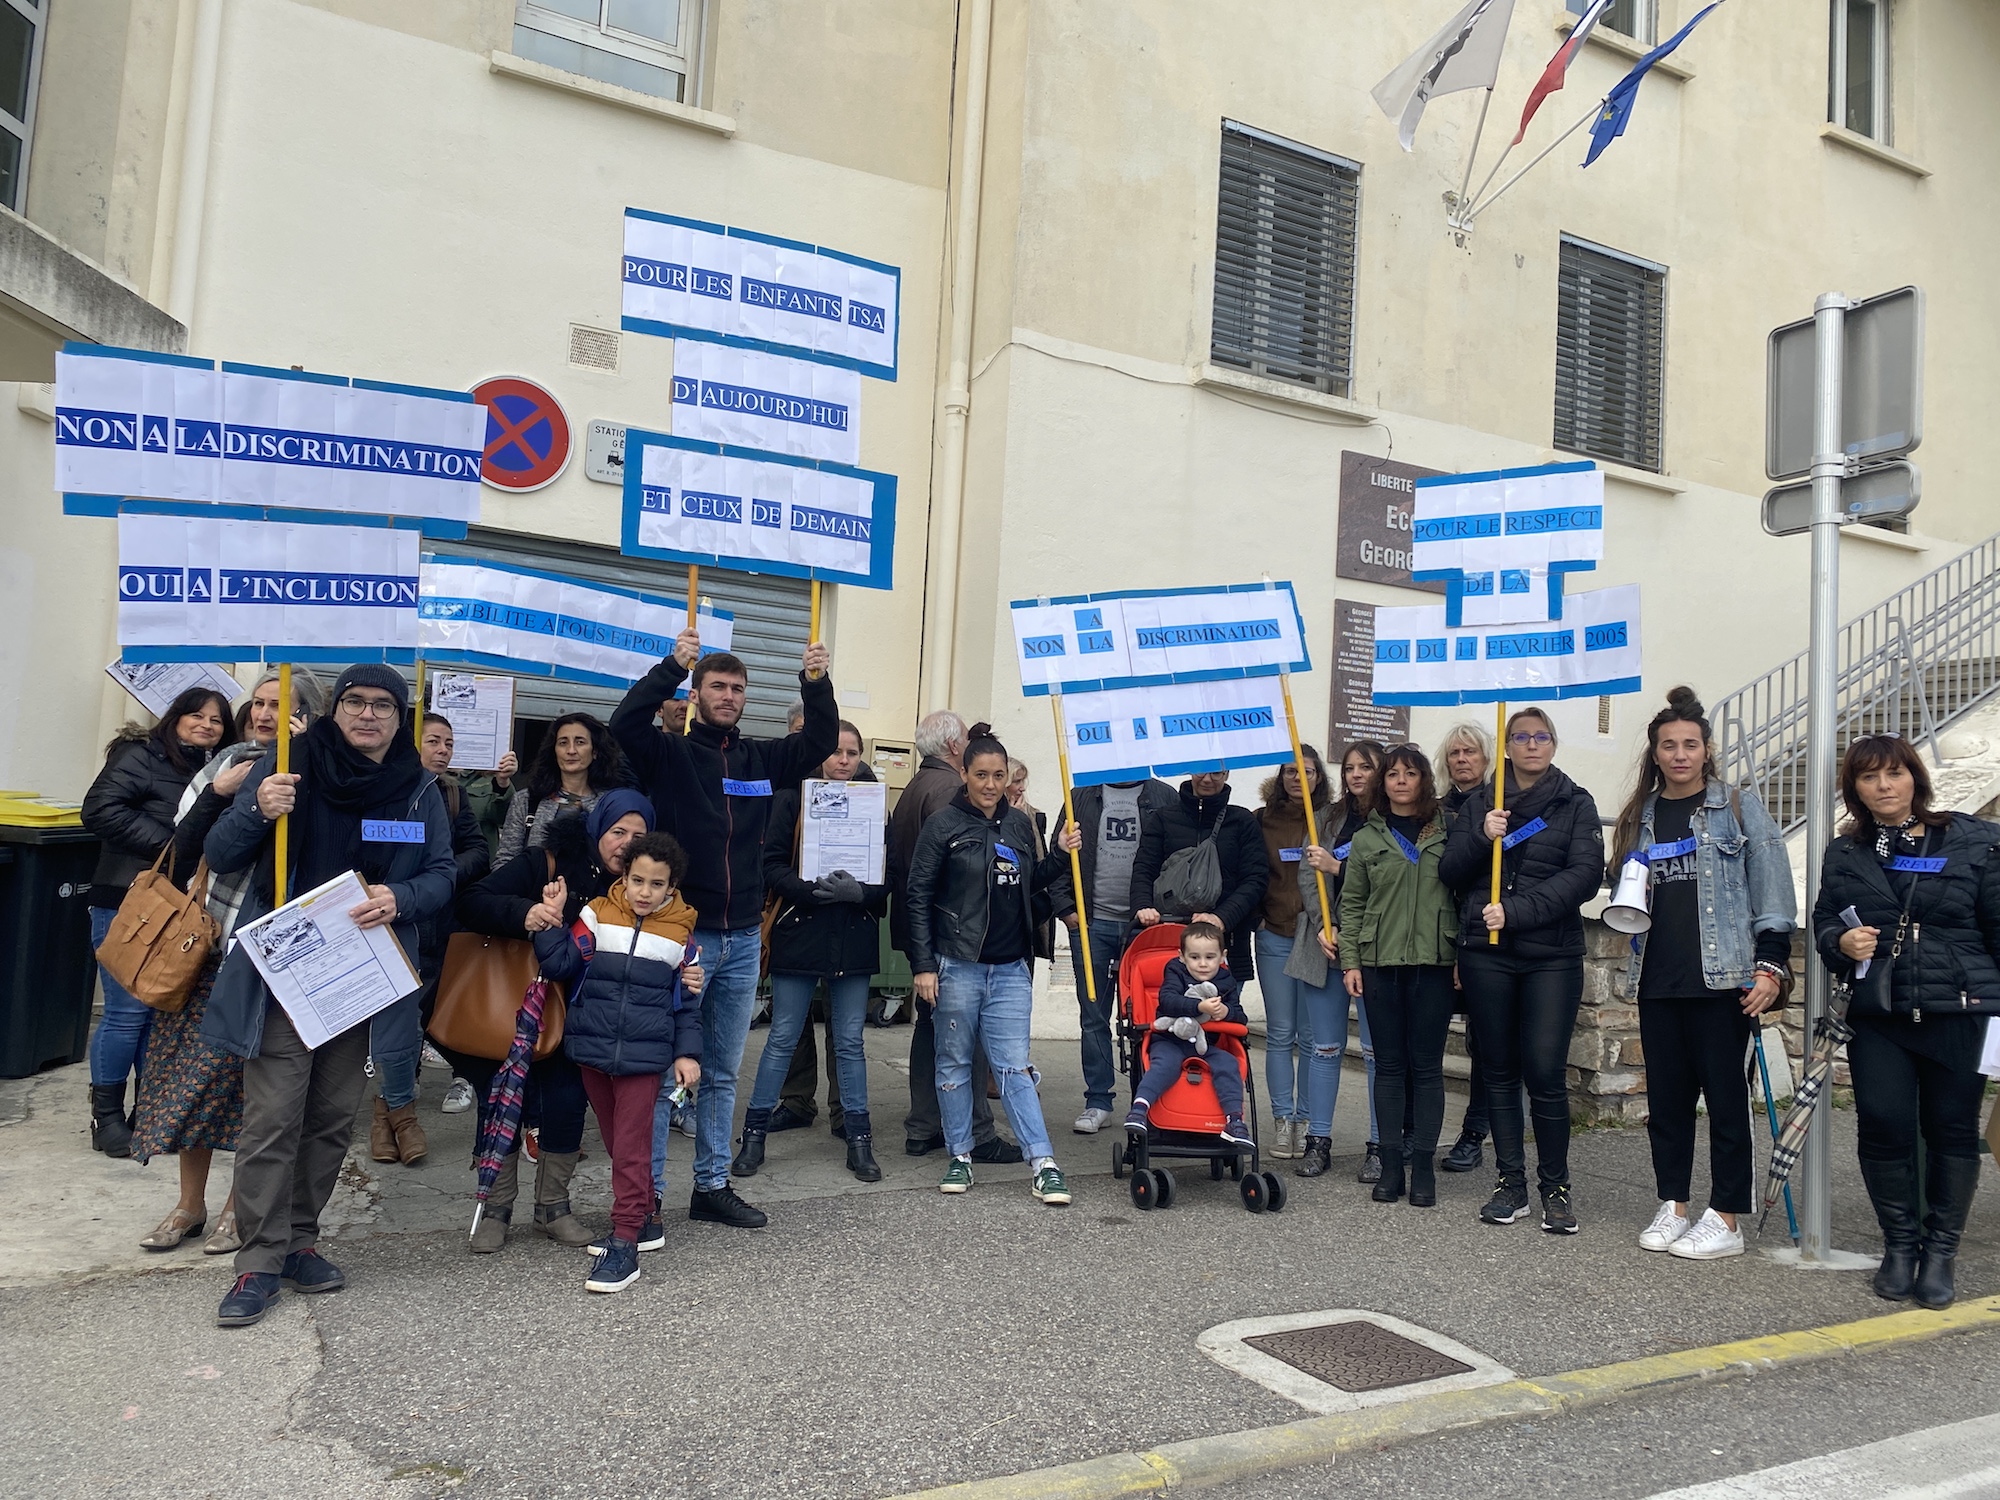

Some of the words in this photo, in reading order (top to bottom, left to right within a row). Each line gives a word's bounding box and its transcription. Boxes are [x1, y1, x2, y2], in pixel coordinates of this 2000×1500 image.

[624, 260, 686, 289] POUR
[692, 272, 732, 297] LES
[746, 282, 842, 319] ENFANTS
[849, 304, 885, 330] TSA
[595, 425, 625, 438] STATIO
[57, 414, 136, 445] NON
[143, 424, 168, 448] A
[176, 426, 221, 453] LA
[224, 430, 482, 478] DISCRIMINATION
[1371, 472, 1413, 493] LIBERTE
[641, 490, 671, 510] ET
[682, 495, 742, 520] CEUX
[752, 503, 781, 525] DE
[791, 510, 871, 540] DEMAIN
[1386, 504, 1414, 533] EC
[1414, 520, 1468, 539] POUR
[1475, 517, 1501, 535] LE
[1505, 510, 1599, 532] RESPECT
[119, 573, 184, 597] OUI
[188, 575, 211, 598] A
[220, 575, 418, 604] L'INCLUSION
[1465, 576, 1493, 594] DE
[1501, 575, 1530, 591] LA
[419, 601, 536, 629] CESSIBILITE
[541, 617, 555, 632] A
[558, 617, 606, 642] TOUS
[611, 630, 632, 647] ET
[1090, 612, 1103, 627] A
[1024, 638, 1064, 656] NON
[1088, 635, 1114, 651] LA
[1137, 622, 1282, 647] DISCRIMINATION
[1376, 644, 1410, 660] LOI
[1417, 643, 1447, 659] DU
[1458, 641, 1475, 657] 11
[1487, 635, 1574, 657] FEVRIER
[1586, 626, 1627, 648] 2005
[1077, 726, 1112, 742] OUI
[1135, 723, 1148, 737] A
[1162, 710, 1274, 734] L'INCLUSION
[724, 782, 771, 794] GREVE
[363, 824, 425, 840] GREVE
